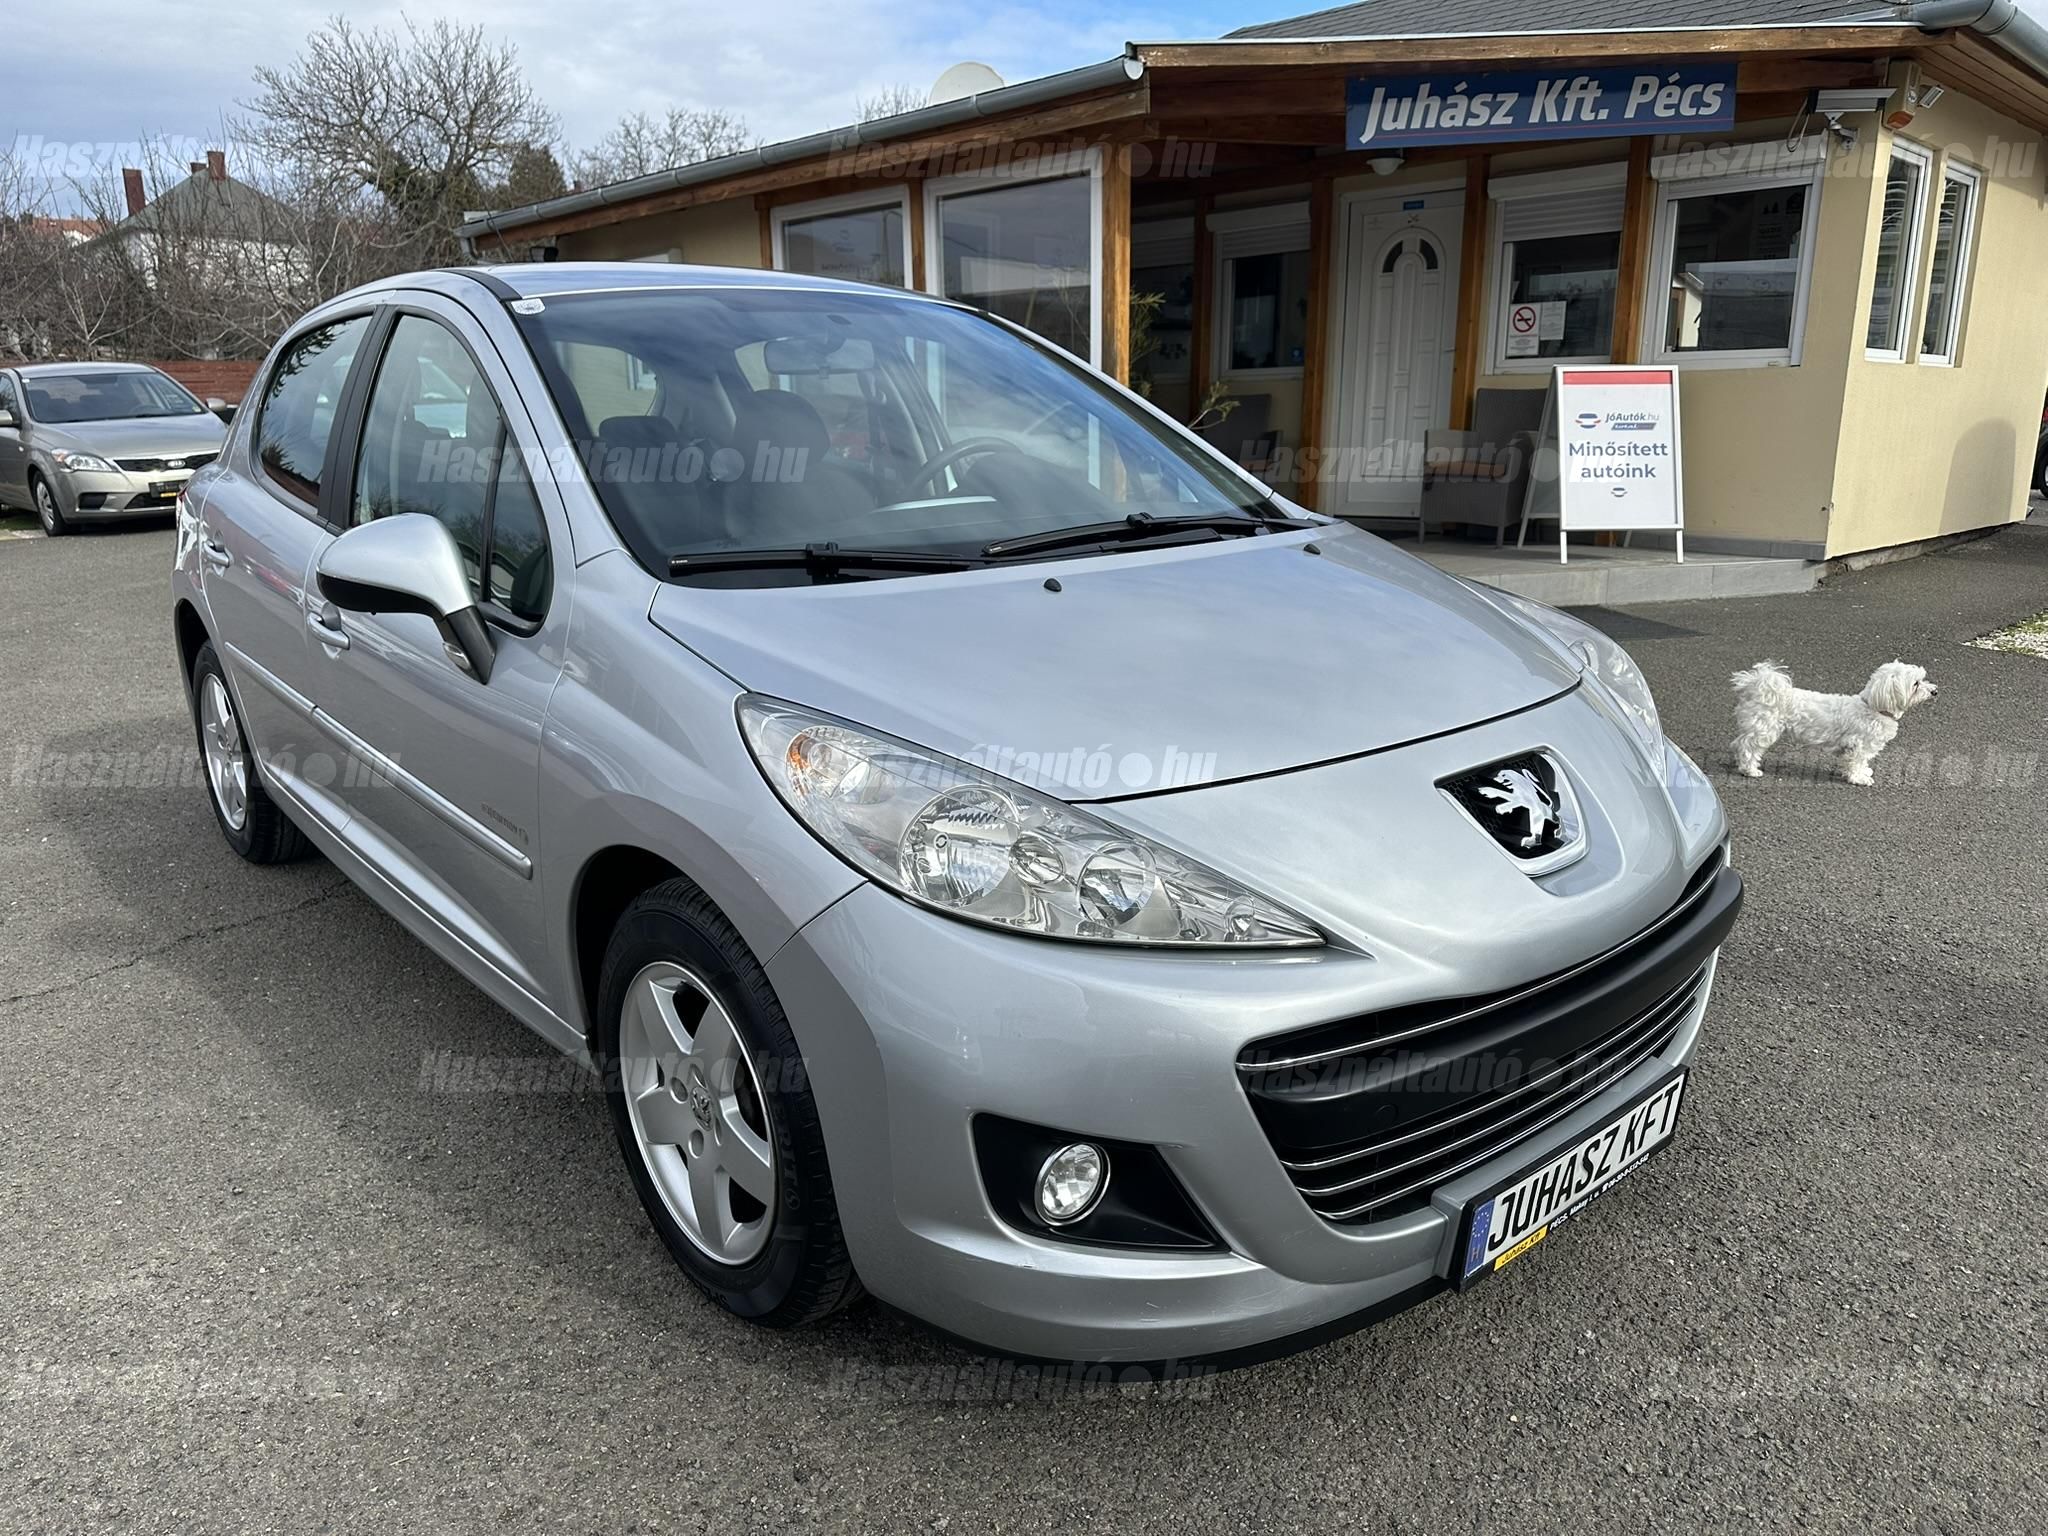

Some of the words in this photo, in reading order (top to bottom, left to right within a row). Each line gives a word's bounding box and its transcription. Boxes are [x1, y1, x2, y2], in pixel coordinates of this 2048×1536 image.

[1359, 81, 1519, 144] Juhász
[1528, 76, 1609, 124] Kft.
[1623, 72, 1725, 119] Pécs
[1569, 441, 1668, 457] Minősített
[1581, 463, 1656, 478] autóink
[1487, 1125, 1621, 1251] JUHASZ
[1618, 1081, 1680, 1164] KFT
